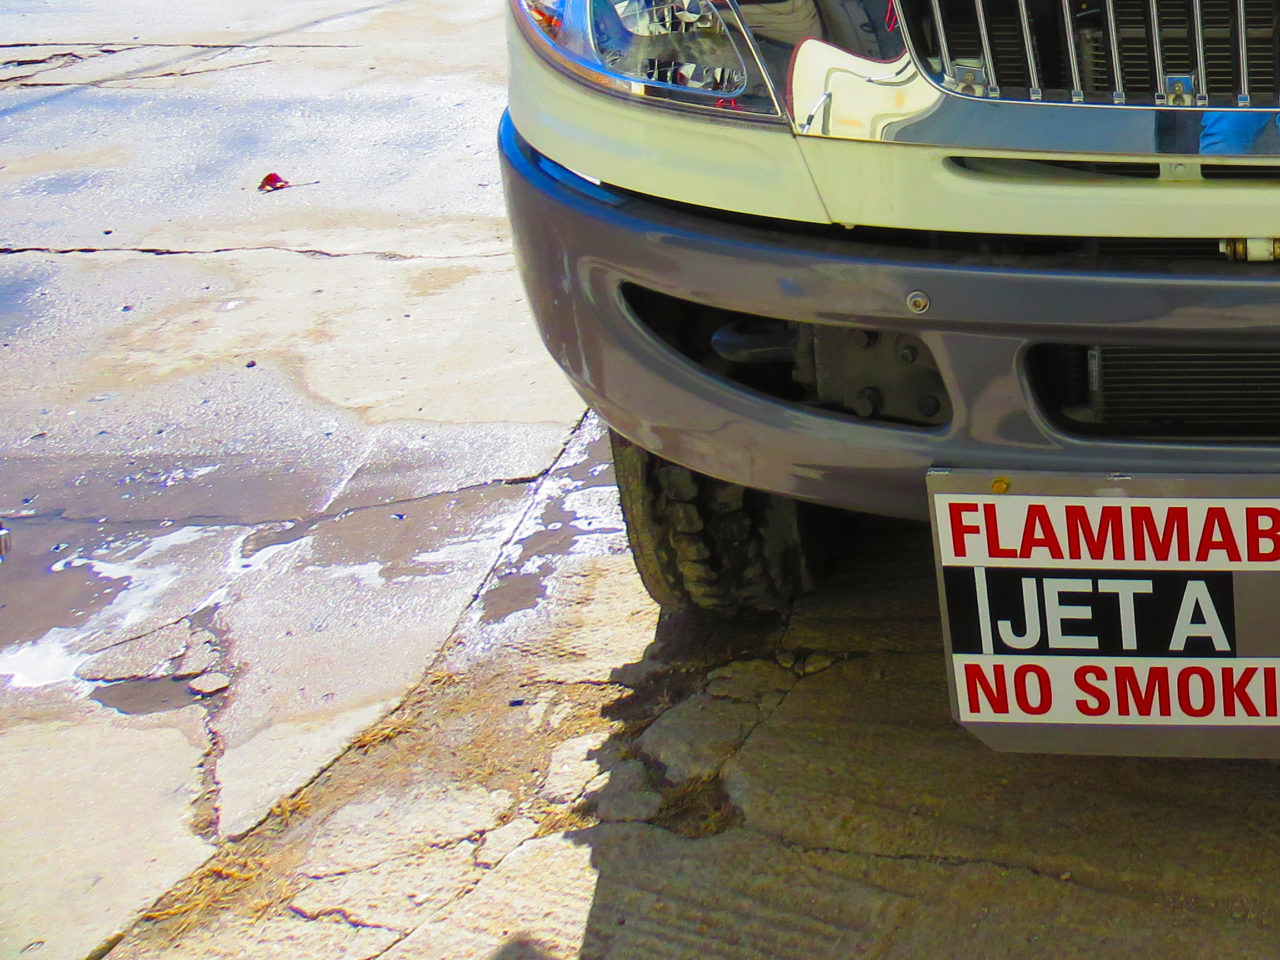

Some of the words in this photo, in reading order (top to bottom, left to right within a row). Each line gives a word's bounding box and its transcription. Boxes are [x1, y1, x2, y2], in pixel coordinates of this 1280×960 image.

[996, 578, 1153, 650] JET
[1169, 580, 1230, 651] A
[965, 663, 1052, 715] NO
